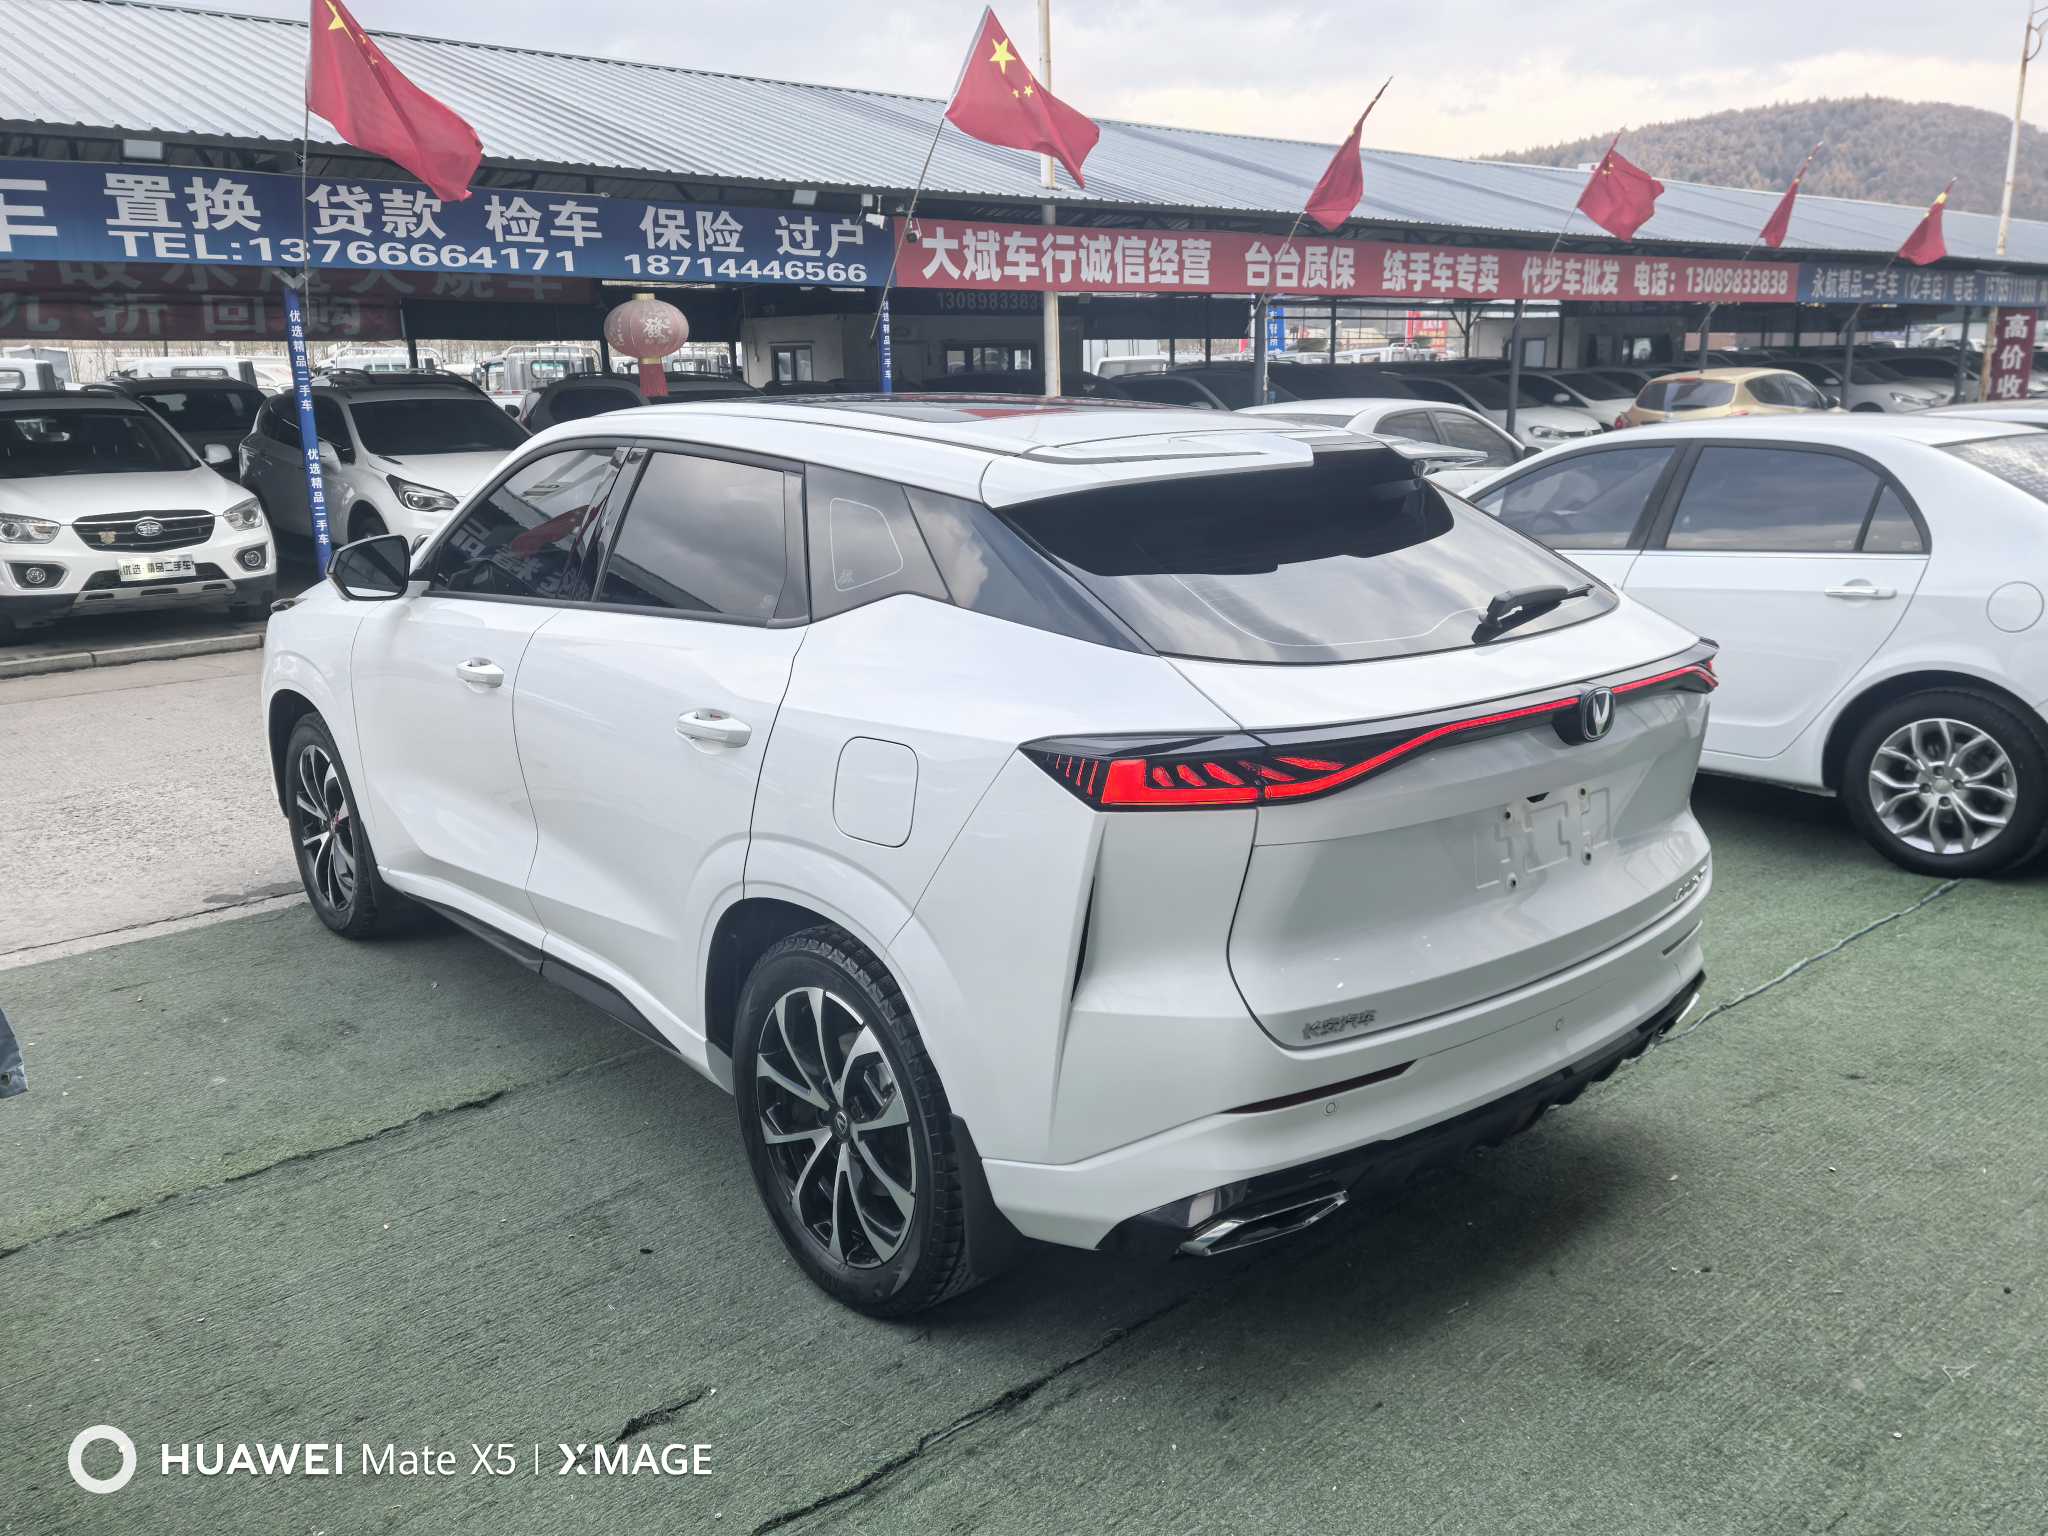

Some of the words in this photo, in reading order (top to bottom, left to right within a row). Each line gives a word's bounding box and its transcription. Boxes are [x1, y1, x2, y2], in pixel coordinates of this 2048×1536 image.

[103, 172, 262, 232] 置换
[306, 184, 446, 240] 贷款
[484, 194, 602, 247] 检车
[639, 205, 745, 253] 保险
[775, 215, 864, 258] 过户
[624, 254, 868, 282] 18714446566
[921, 226, 1212, 286] 大斌车行诚信经营
[1244, 241, 1356, 289] 台台质保
[1382, 249, 1500, 293] 练手车专卖
[1522, 256, 1620, 295] 代步车批发
[289, 309, 313, 411] 优选精品二手车
[307, 448, 330, 545] 优选精品二手车
